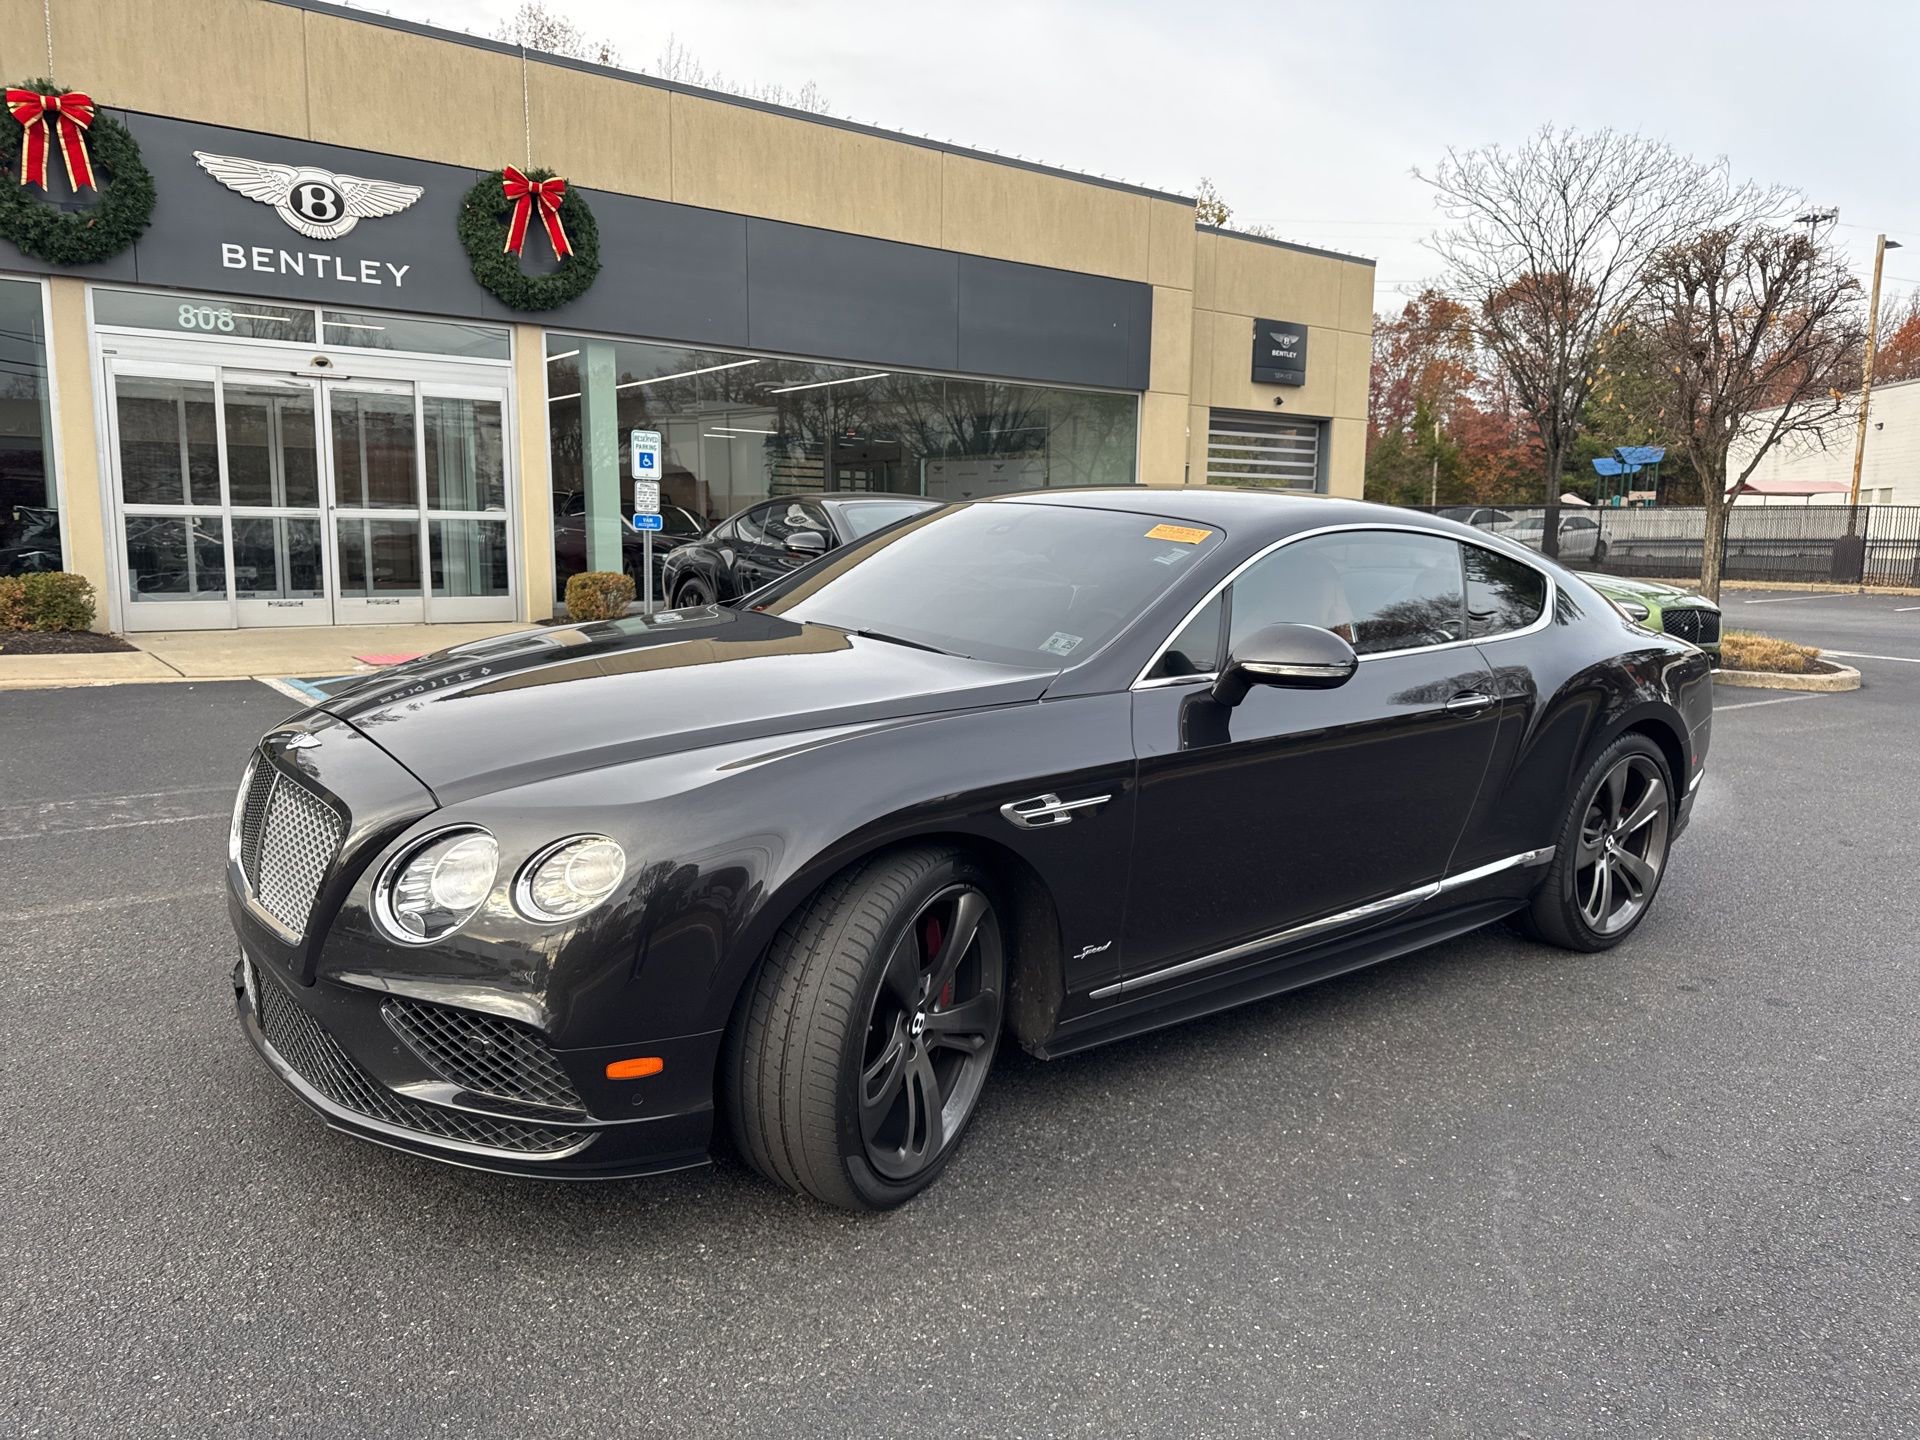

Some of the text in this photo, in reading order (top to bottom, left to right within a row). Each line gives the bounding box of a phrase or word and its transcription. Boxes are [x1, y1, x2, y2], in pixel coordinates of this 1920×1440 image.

[299, 184, 337, 220] B
[221, 243, 410, 287] BENTLEY
[178, 304, 235, 331] 808
[1271, 350, 1297, 358] BENTLEY
[634, 435, 658, 444] RESERVED
[635, 443, 657, 452] PARKING
[1073, 940, 1112, 960] Speed
